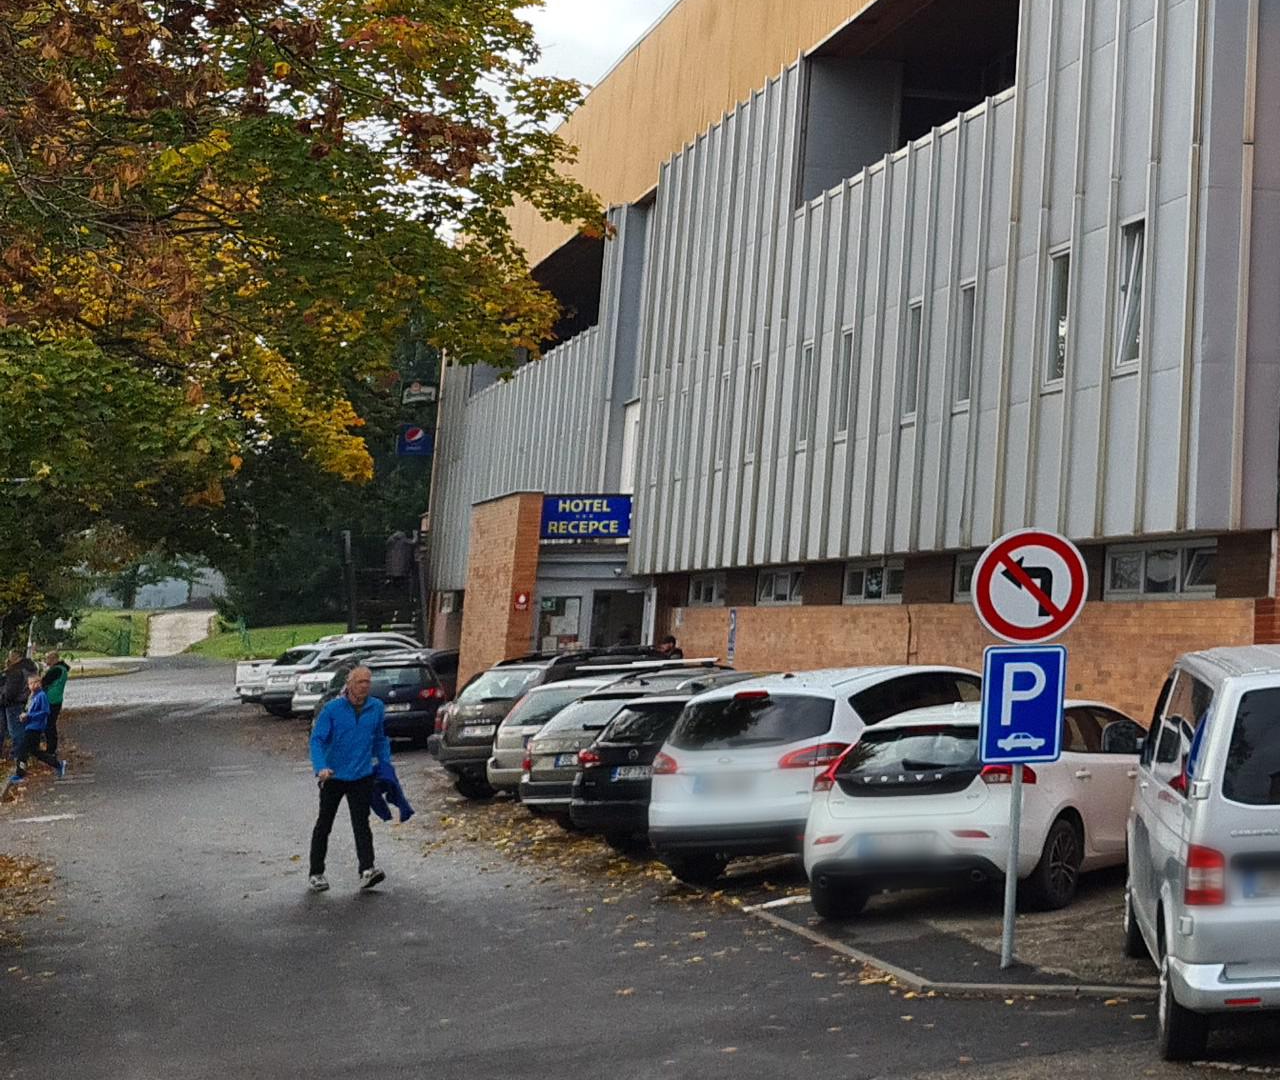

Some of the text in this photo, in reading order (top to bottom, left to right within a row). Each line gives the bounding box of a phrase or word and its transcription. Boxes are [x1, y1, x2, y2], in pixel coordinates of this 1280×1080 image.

[558, 499, 611, 513] HOTEL
[548, 520, 619, 534] RECEPCE
[1001, 662, 1046, 726] P
